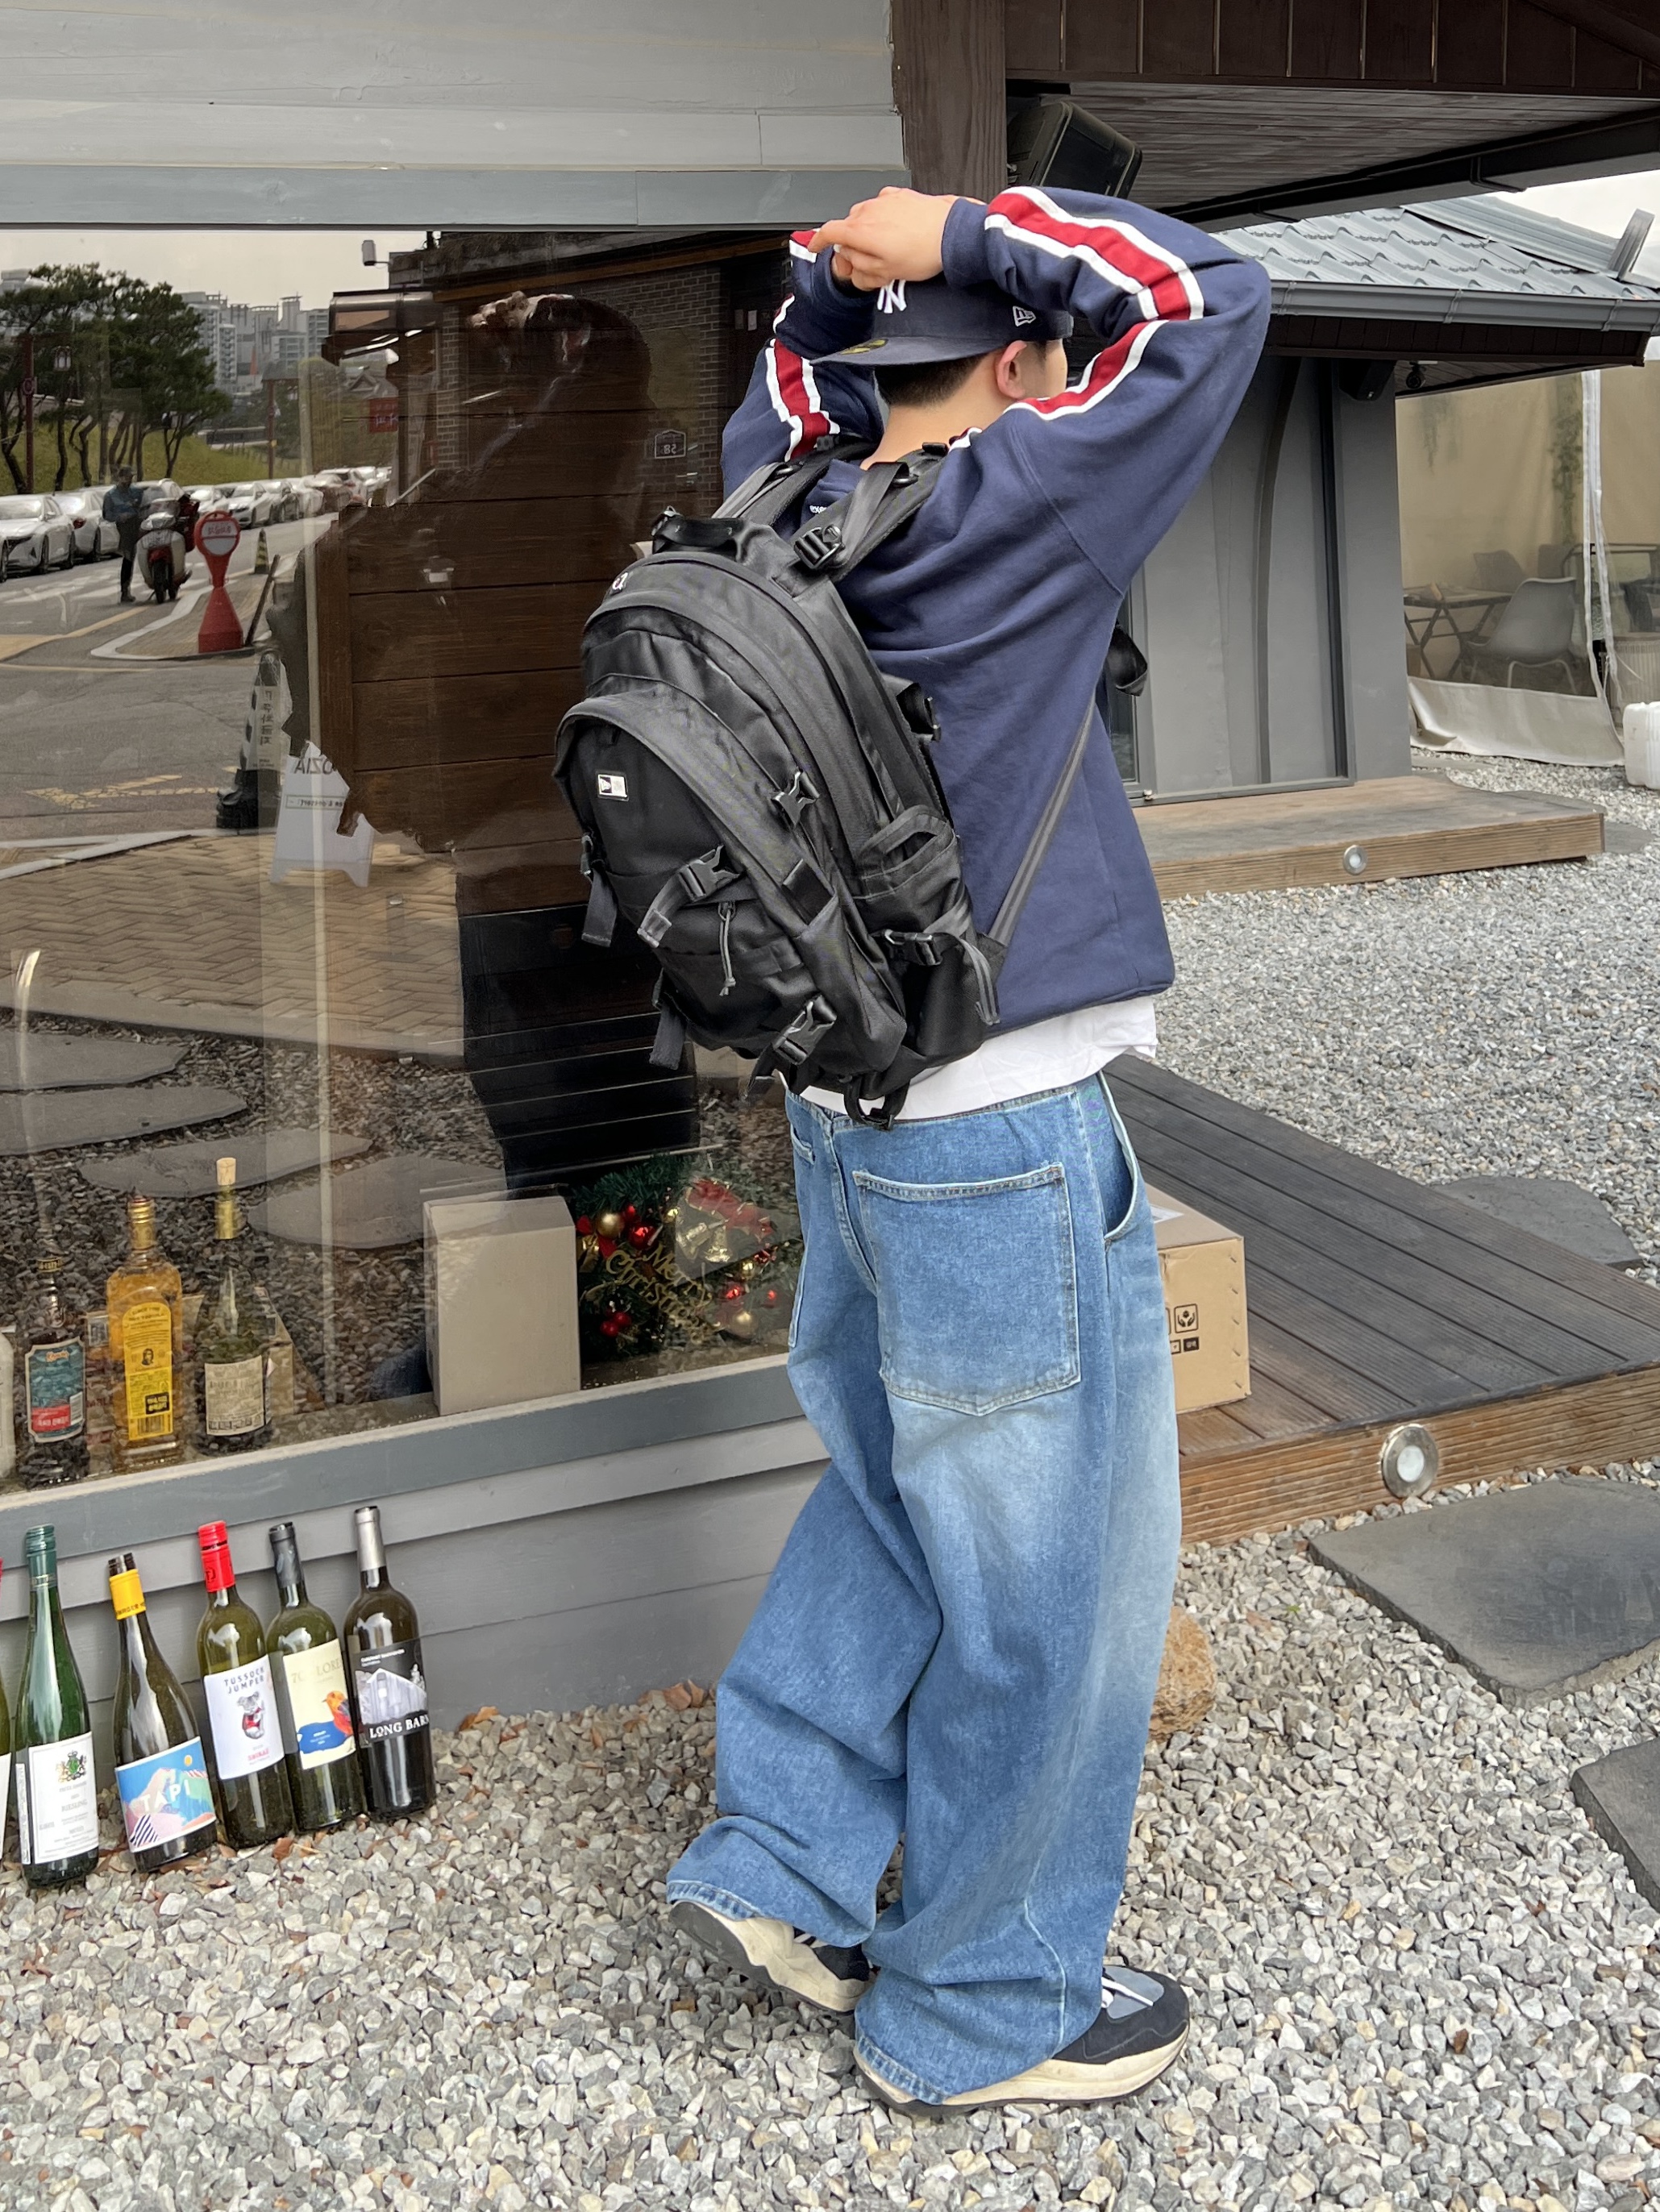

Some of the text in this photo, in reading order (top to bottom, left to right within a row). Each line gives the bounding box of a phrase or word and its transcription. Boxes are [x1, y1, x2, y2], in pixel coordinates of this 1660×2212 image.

[643, 1243, 713, 1306] Merry
[224, 1665, 264, 1686] TUSSOCK
[228, 1674, 264, 1694] JUMPER
[369, 1722, 402, 1740] LONG
[139, 1778, 191, 1812] TAPI
